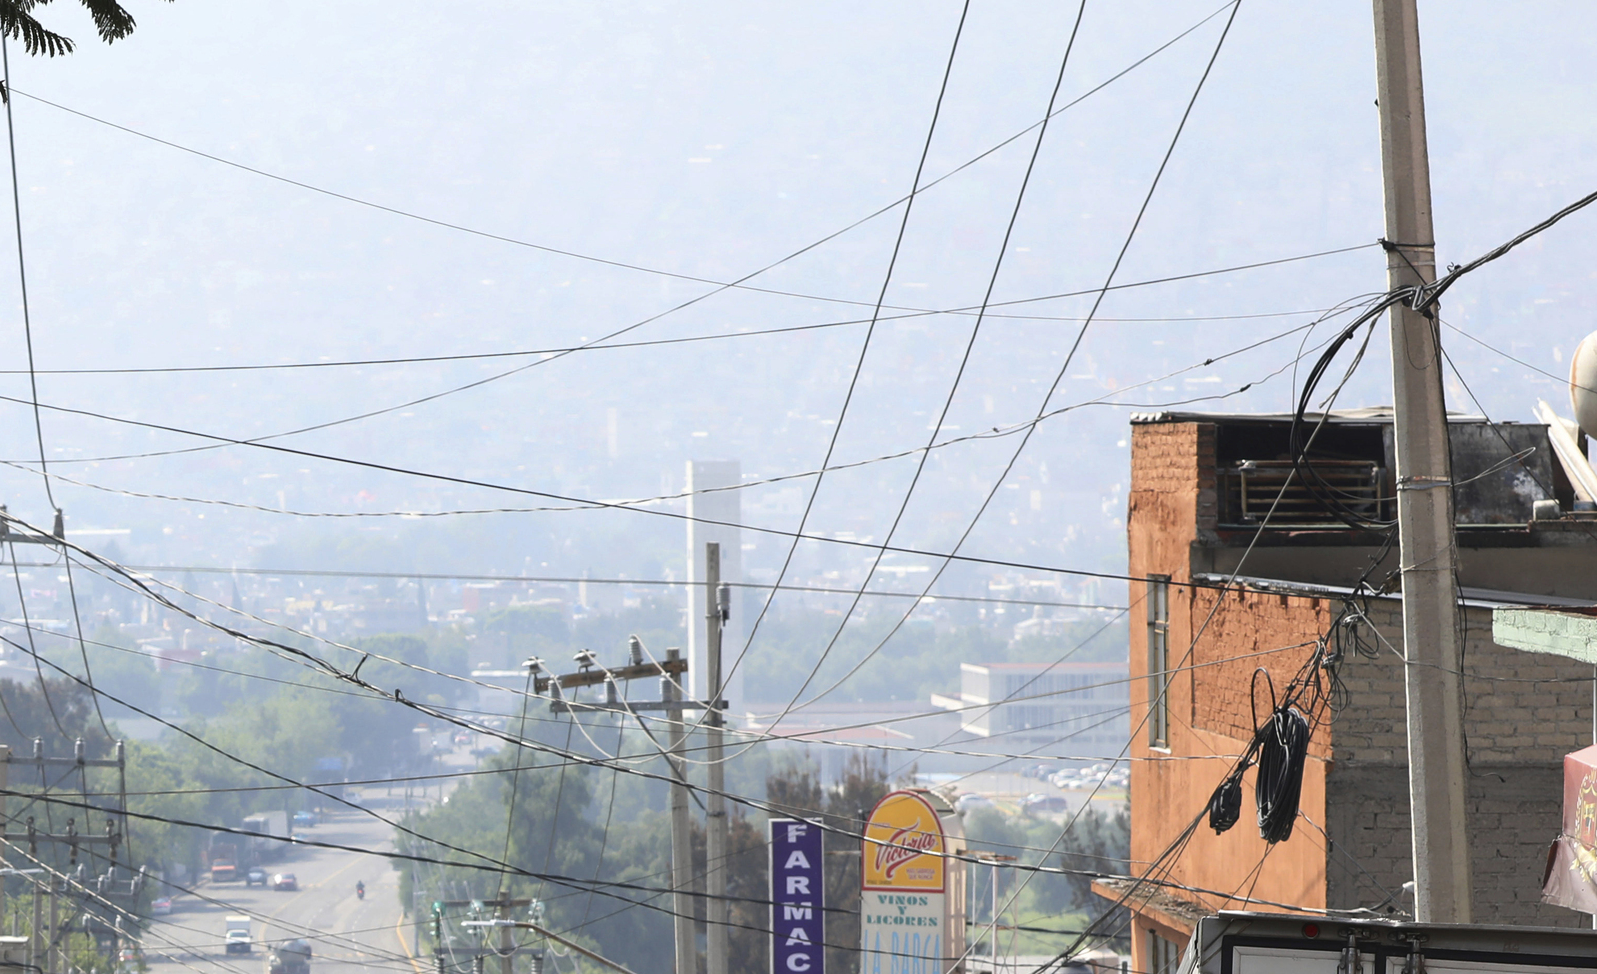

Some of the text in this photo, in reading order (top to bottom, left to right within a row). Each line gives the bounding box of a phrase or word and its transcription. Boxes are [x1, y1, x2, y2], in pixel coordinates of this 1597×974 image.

[875, 819, 938, 878] Victoria
[877, 894, 928, 906] VINOS
[897, 905, 907, 915] Y
[867, 914, 938, 927] LICORES
